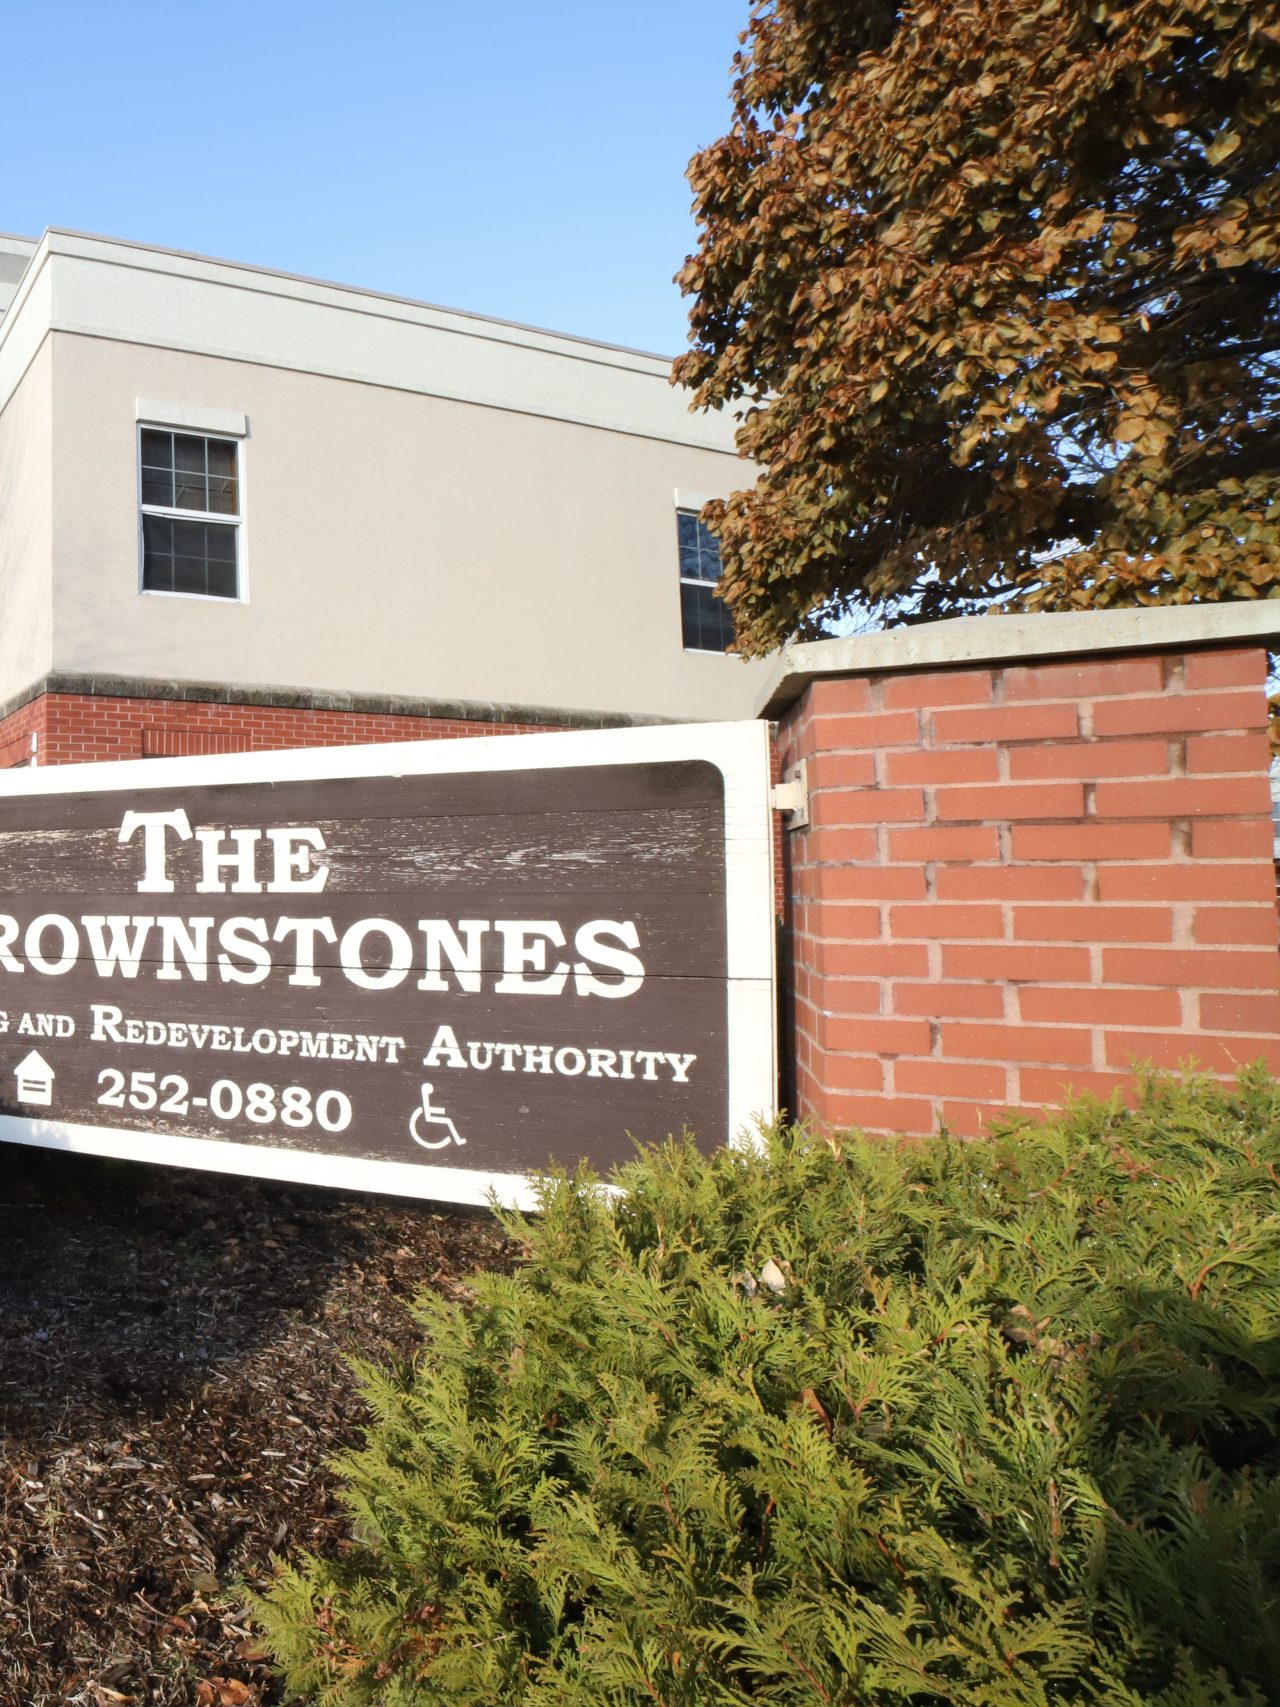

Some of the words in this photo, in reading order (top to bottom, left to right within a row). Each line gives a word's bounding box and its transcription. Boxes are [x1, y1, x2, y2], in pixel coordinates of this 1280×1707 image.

[118, 808, 329, 893] THE
[18, 1014, 75, 1038] AND
[89, 1005, 405, 1063] REDEVELOPMENT
[423, 1025, 697, 1082] AUTHORITY
[97, 1069, 352, 1132] 252-0880
